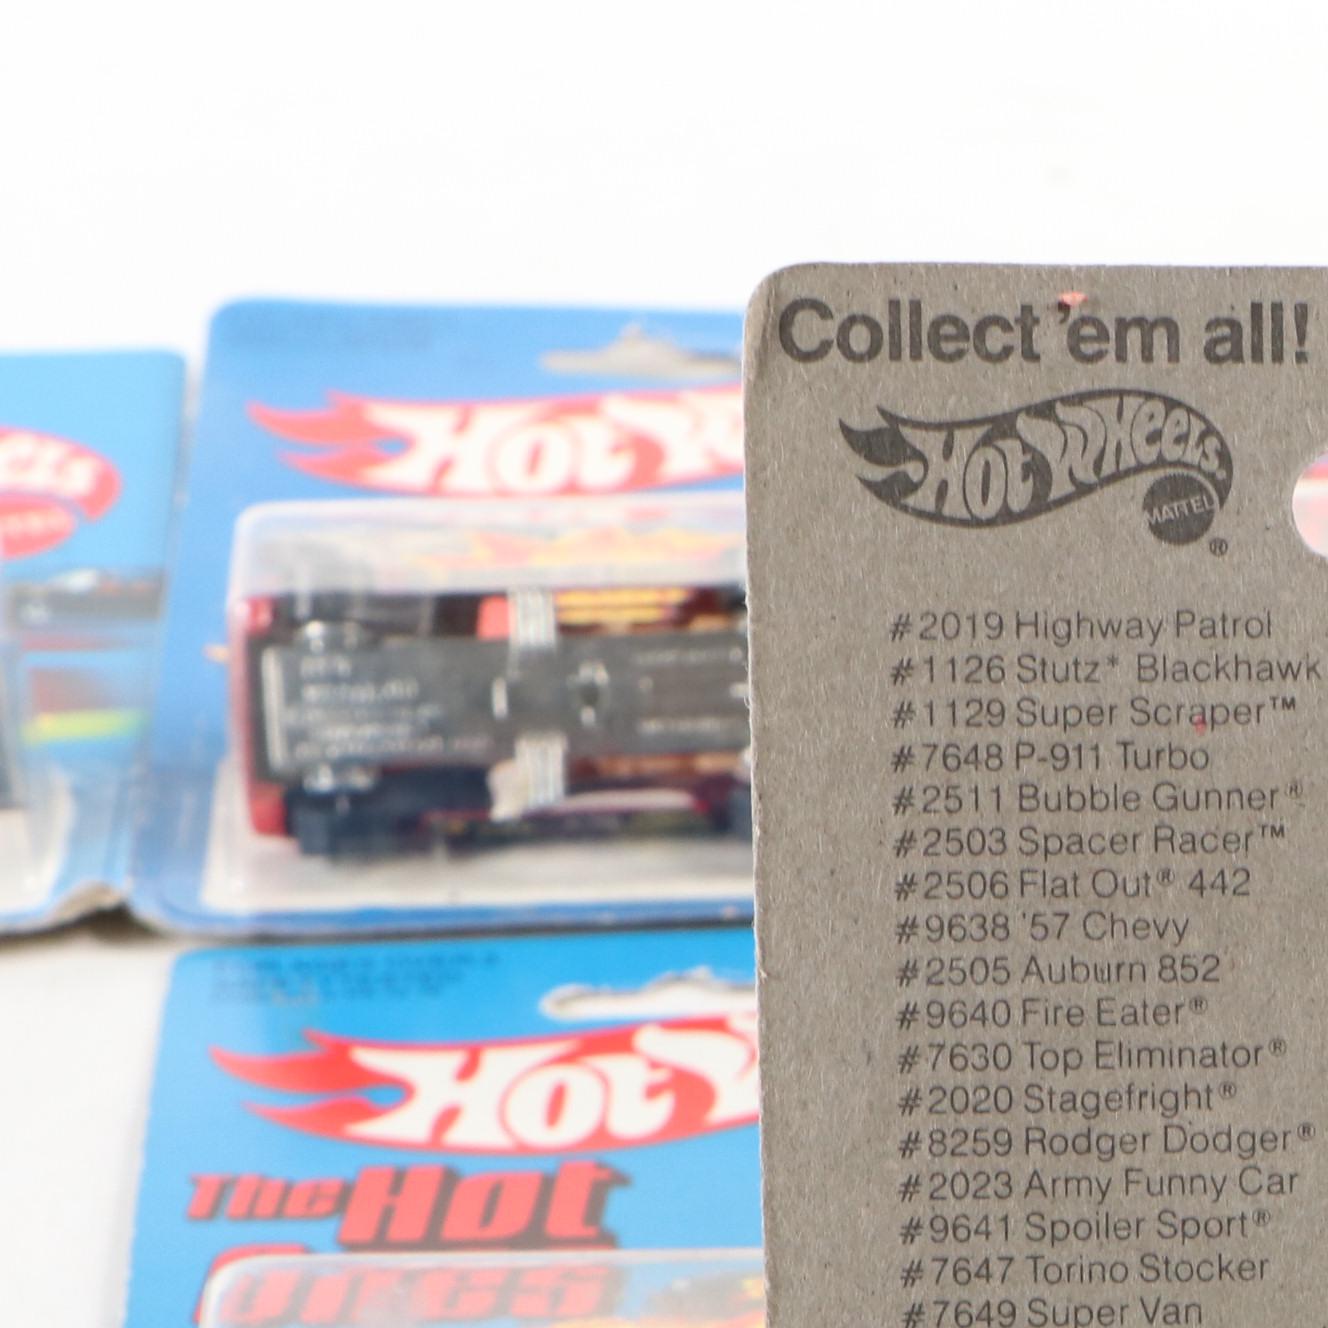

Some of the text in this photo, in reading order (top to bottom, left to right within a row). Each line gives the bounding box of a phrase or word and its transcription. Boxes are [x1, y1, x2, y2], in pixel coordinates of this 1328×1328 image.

[775, 296, 1309, 366] Collect 'em all!
[1144, 493, 1217, 526] MATTEL
[1016, 611, 1163, 648] Highway
[1175, 609, 1271, 639] Patrol
[1137, 653, 1321, 683] Blackhawk
[1017, 697, 1117, 733] Super
[1015, 740, 1209, 772] P-911 Turbo
[1019, 782, 1140, 812] Bubble
[1019, 825, 1140, 861] Spacer
[1020, 867, 1250, 898] Flat 442
[1083, 910, 1189, 946] Chevy
[1022, 955, 1146, 984] Auburn
[1158, 954, 1220, 983] 852
[1022, 998, 1084, 1027] Fire
[1024, 1041, 1083, 1076] Top
[1025, 1126, 1150, 1162] Rodger
[1024, 1165, 1298, 1205] Army Funny Car
[1026, 1211, 1144, 1247] Spoiler
[1026, 1253, 1268, 1285] Torino Stocker
[1140, 1297, 1202, 1325] Van
